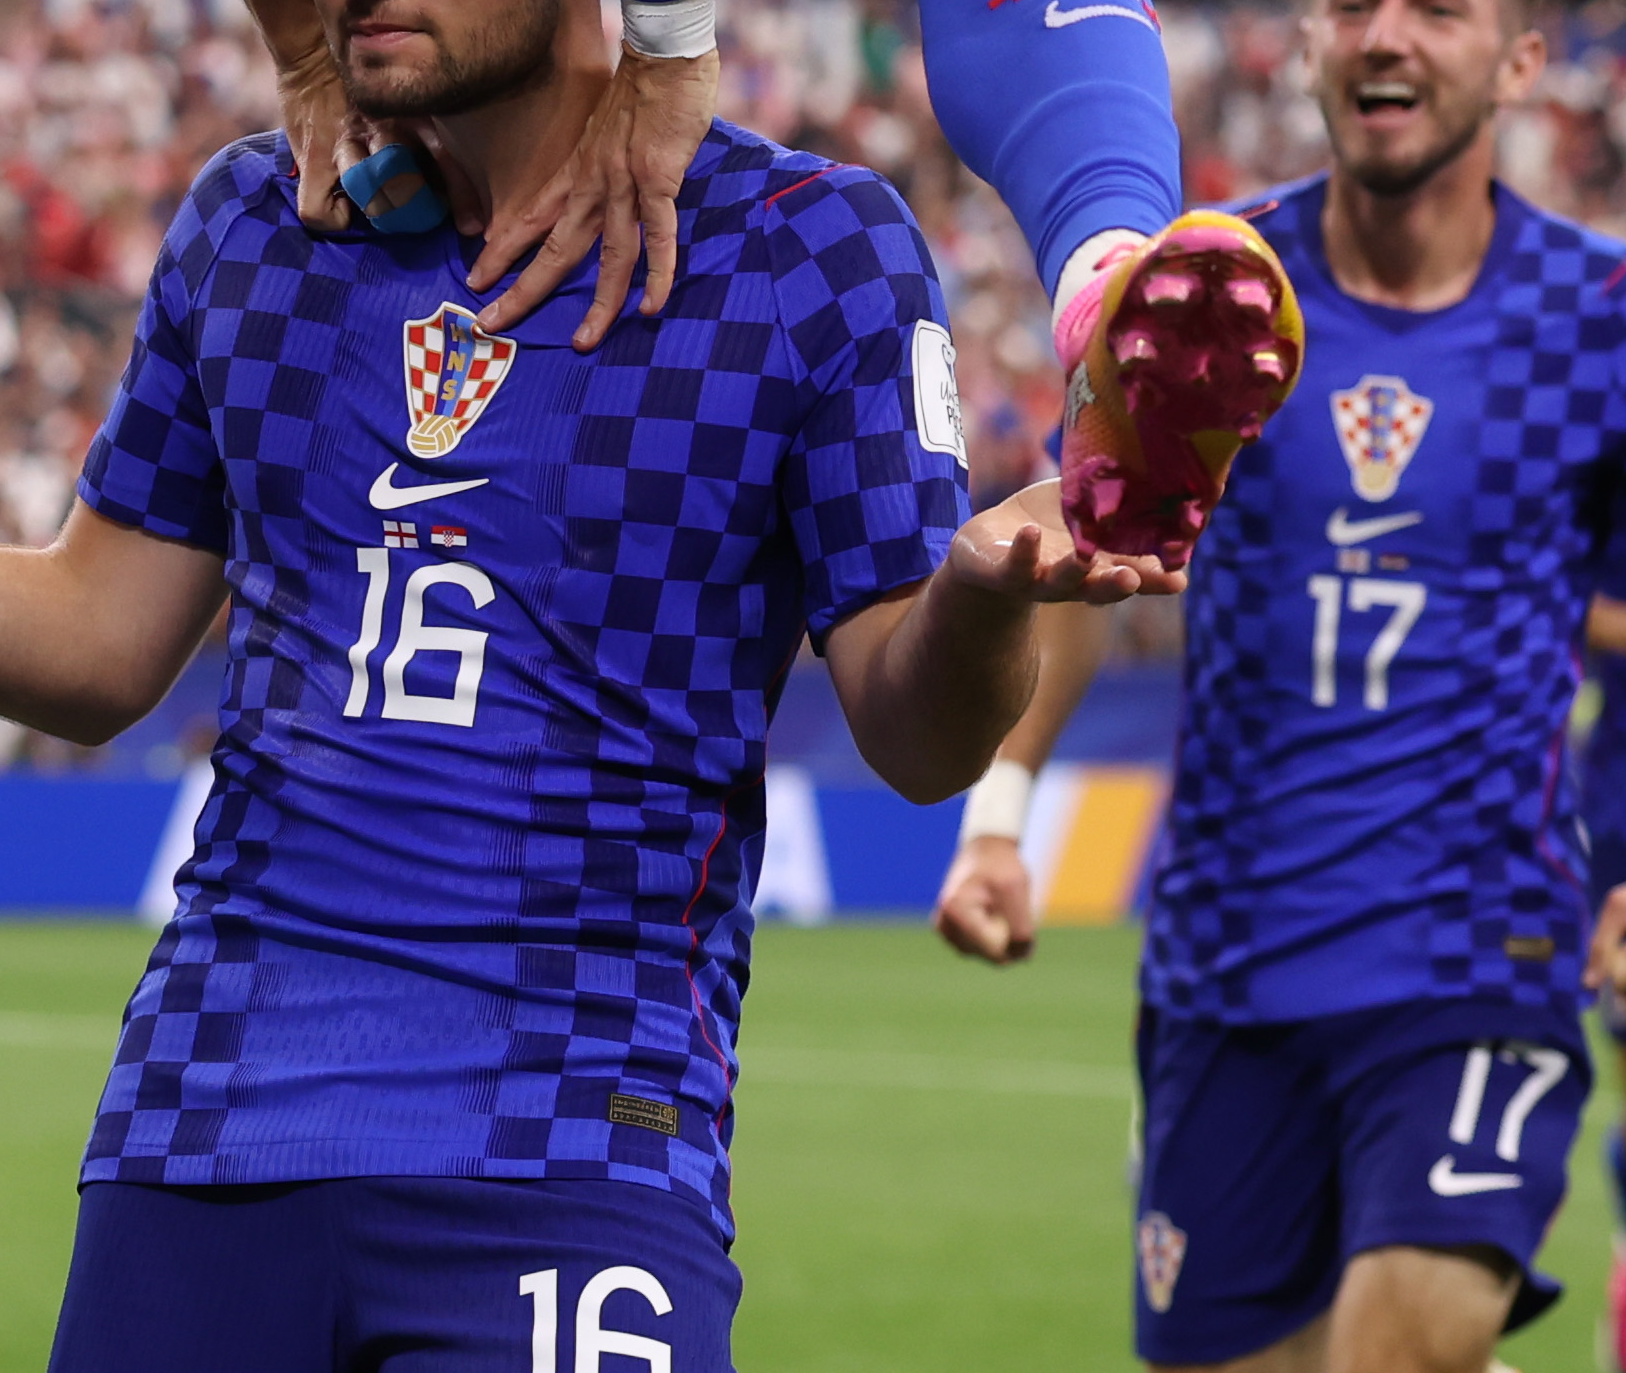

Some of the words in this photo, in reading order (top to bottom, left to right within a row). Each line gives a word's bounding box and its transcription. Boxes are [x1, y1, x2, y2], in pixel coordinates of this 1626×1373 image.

[441, 322, 467, 401] HNS
[342, 547, 496, 728] 16
[1306, 576, 1427, 711] 17
[1448, 1045, 1570, 1163] 17
[519, 1265, 674, 1373] 16
